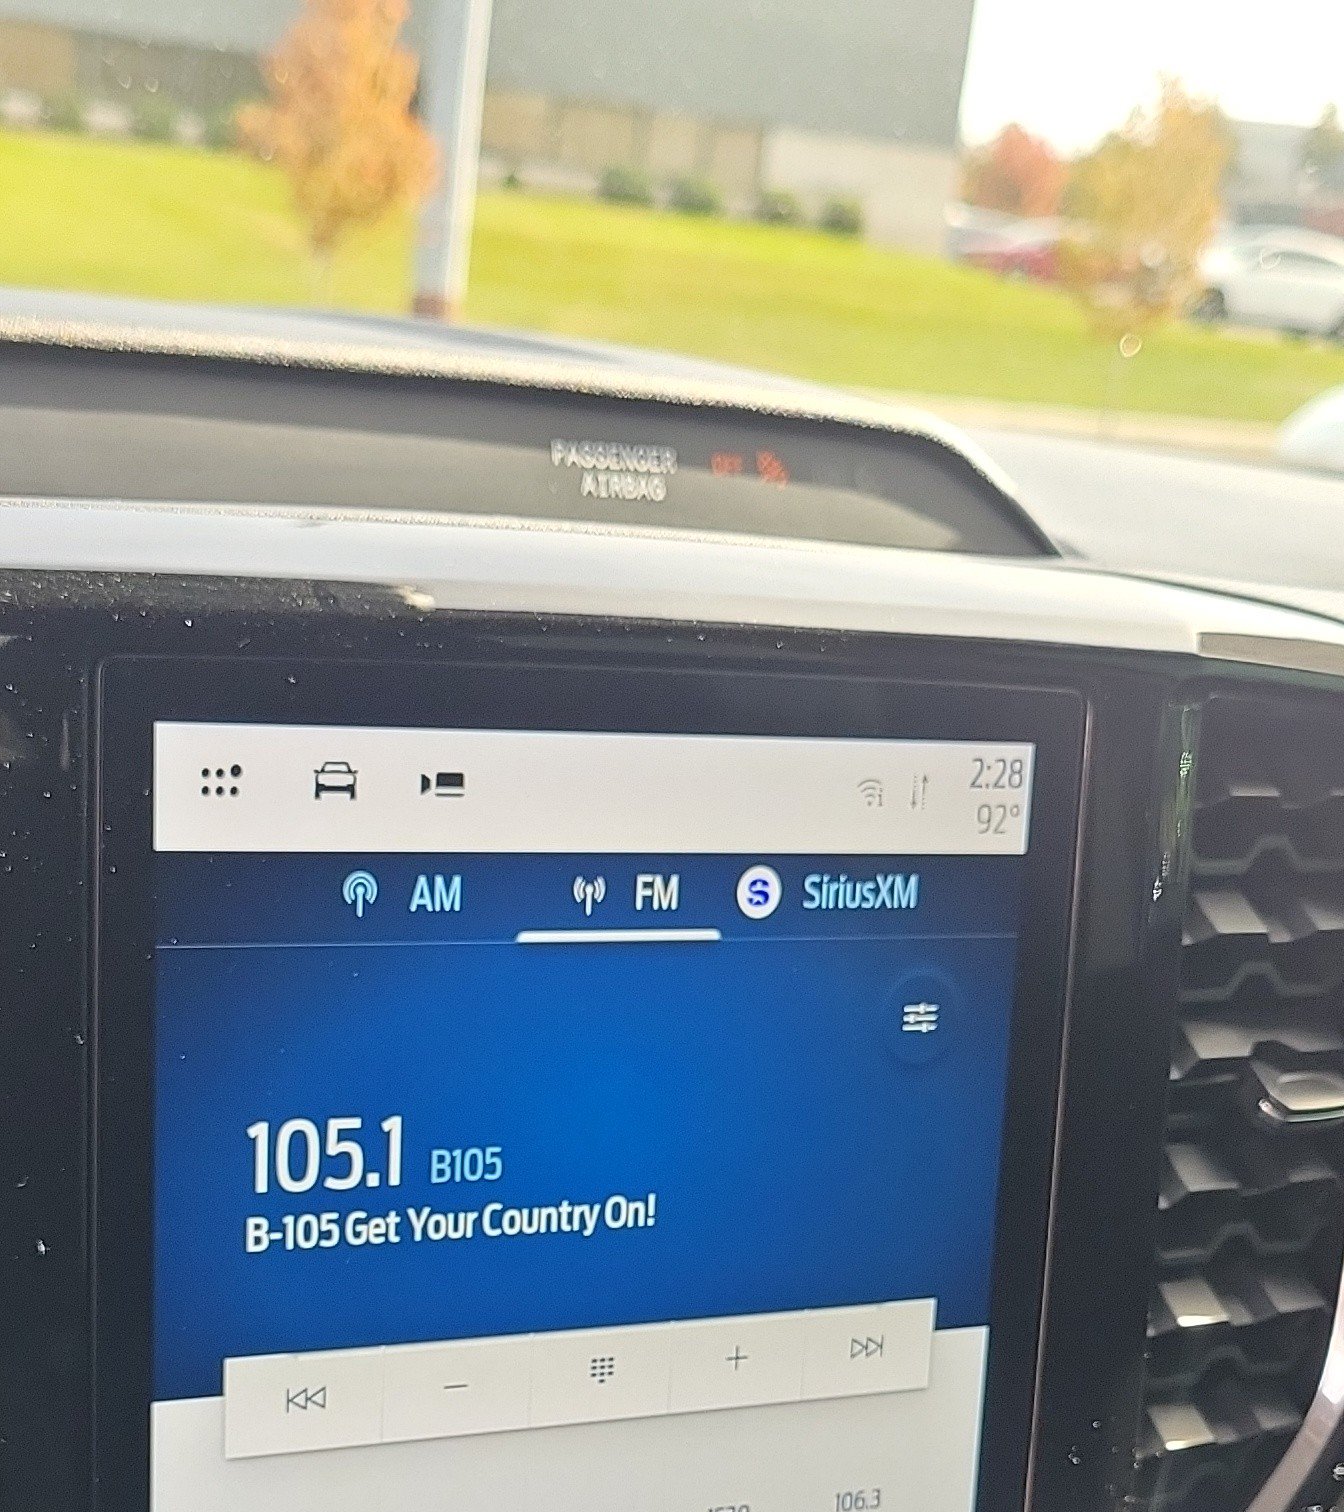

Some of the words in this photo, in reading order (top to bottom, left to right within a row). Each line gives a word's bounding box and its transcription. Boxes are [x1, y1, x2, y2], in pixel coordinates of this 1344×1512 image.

[551, 439, 677, 474] PASSENGER
[581, 469, 666, 501] AIRBAG
[969, 758, 1023, 789] 2:28
[409, 876, 461, 913] AM
[635, 875, 679, 912] FM
[803, 873, 920, 909] SiriusXM
[245, 1115, 404, 1194] 105.1
[430, 1146, 503, 1184] B105
[245, 1213, 340, 1253] B-105
[345, 1210, 400, 1246] Get
[408, 1205, 478, 1242] Your
[482, 1199, 600, 1238] Country
[605, 1193, 656, 1228] On!
